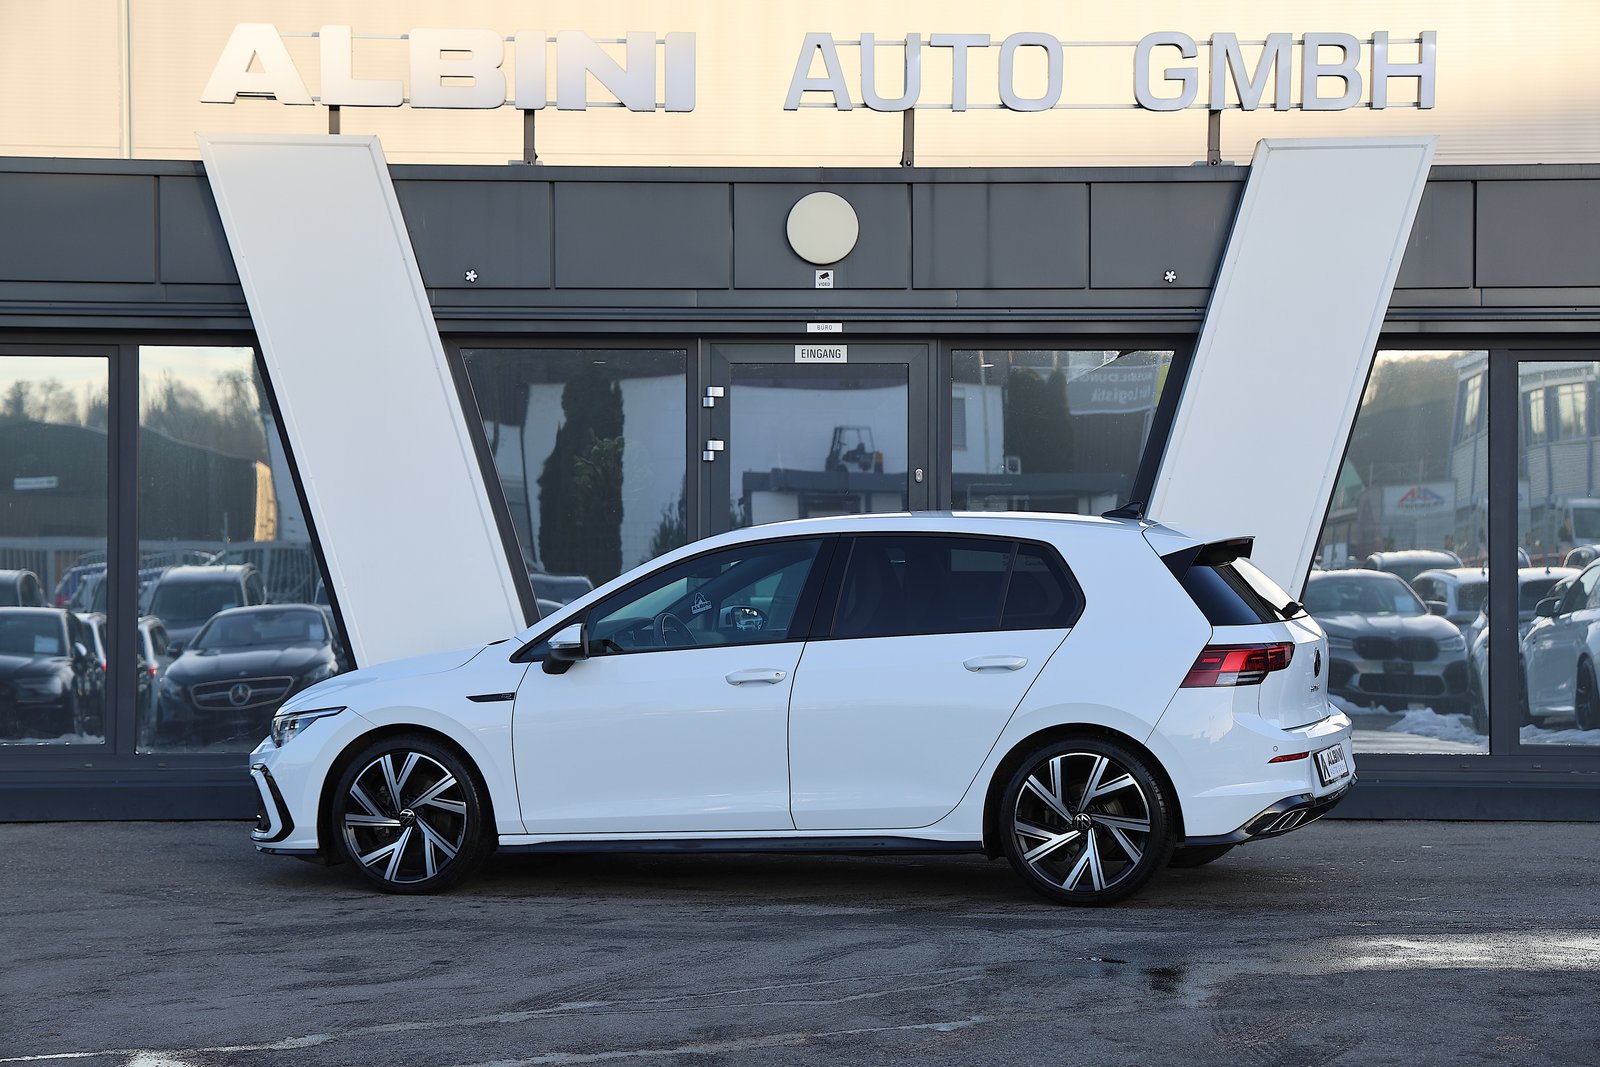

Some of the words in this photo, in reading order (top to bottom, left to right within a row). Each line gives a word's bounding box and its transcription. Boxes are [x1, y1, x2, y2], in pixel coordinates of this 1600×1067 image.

[201, 23, 696, 112] ALBINI
[784, 32, 1063, 112] AUTO
[1134, 30, 1437, 112] GMBH
[801, 348, 842, 359] EINGANG
